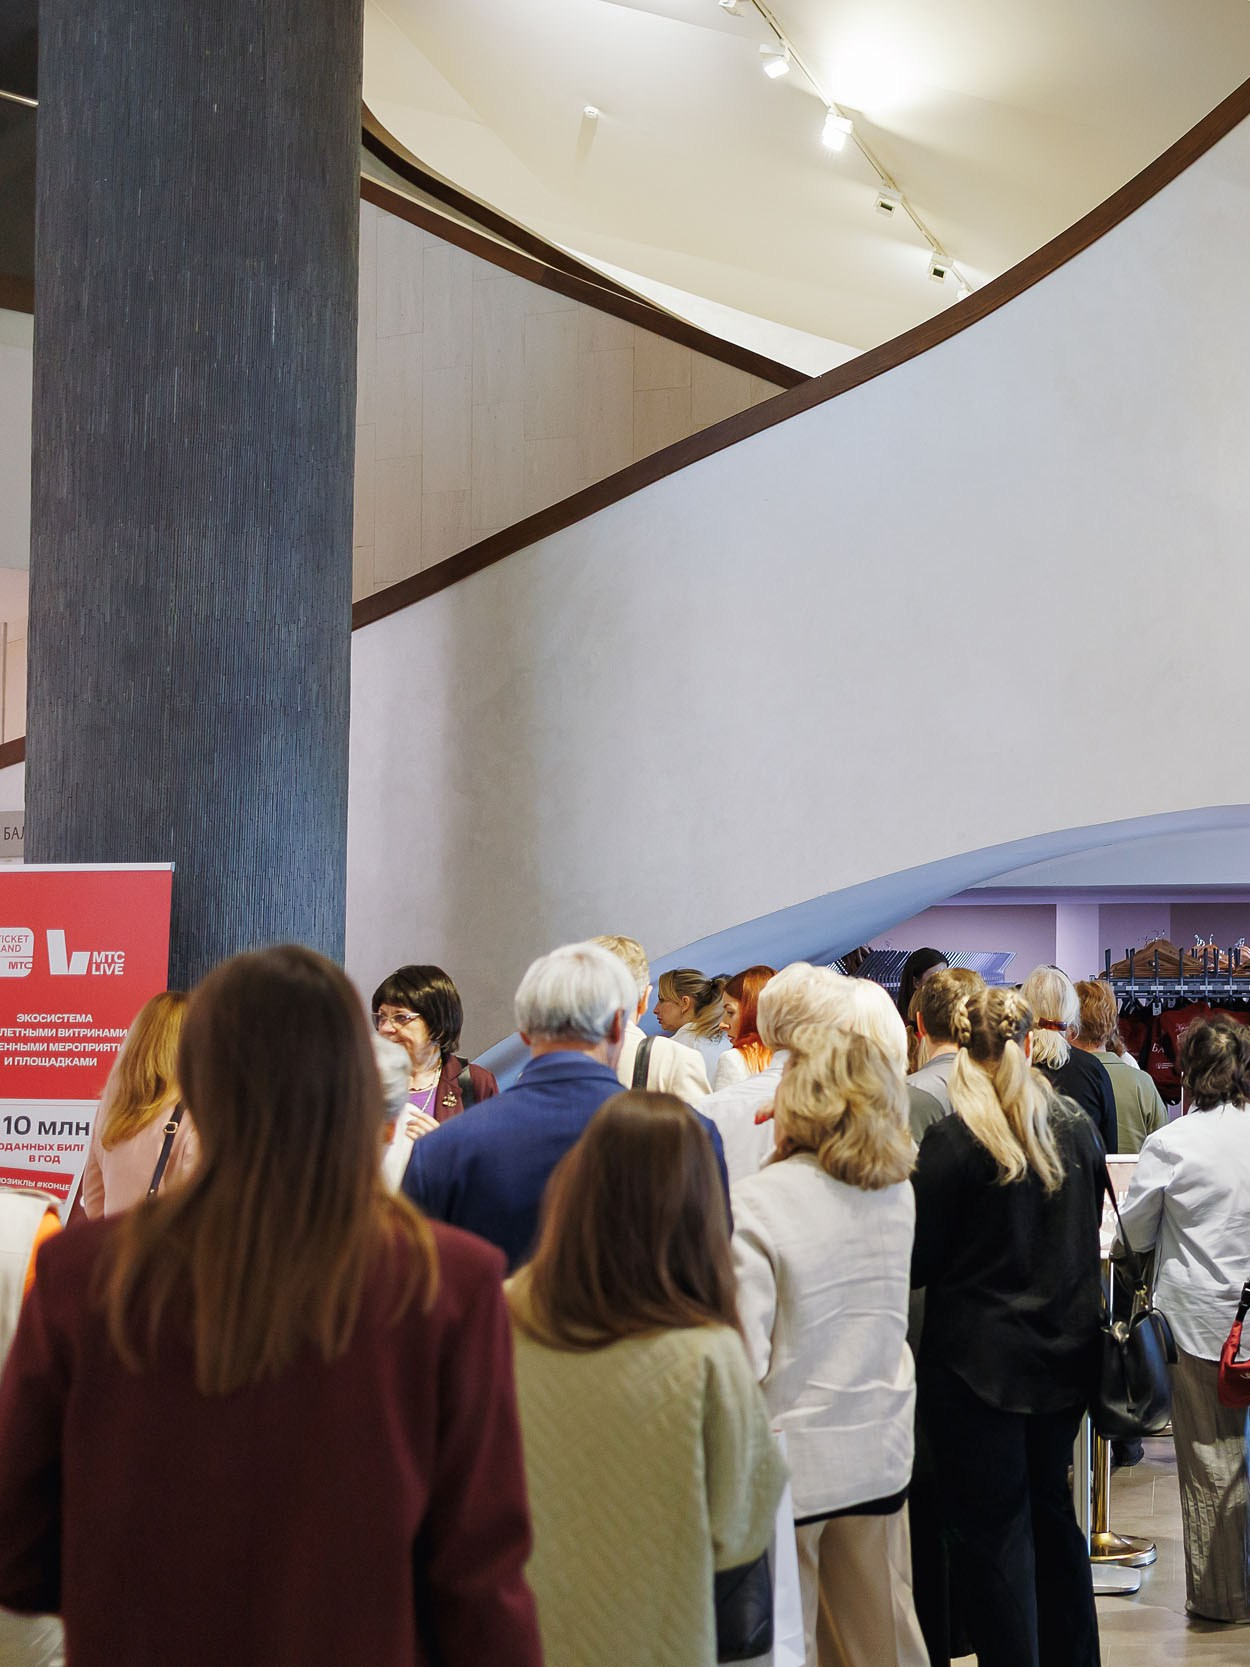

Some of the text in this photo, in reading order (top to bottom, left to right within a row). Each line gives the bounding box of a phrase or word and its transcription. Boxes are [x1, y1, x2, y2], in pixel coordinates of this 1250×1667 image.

[92, 963, 125, 975] LIVE
[17, 1013, 93, 1023] ЭКОСИСТЕМА
[58, 1028, 128, 1038] ВИТРИНАМИ
[4, 1057, 97, 1067] И ПЛОЩАДКАМИ
[3, 1115, 31, 1135] 10
[38, 1155, 61, 1164] ГОД
